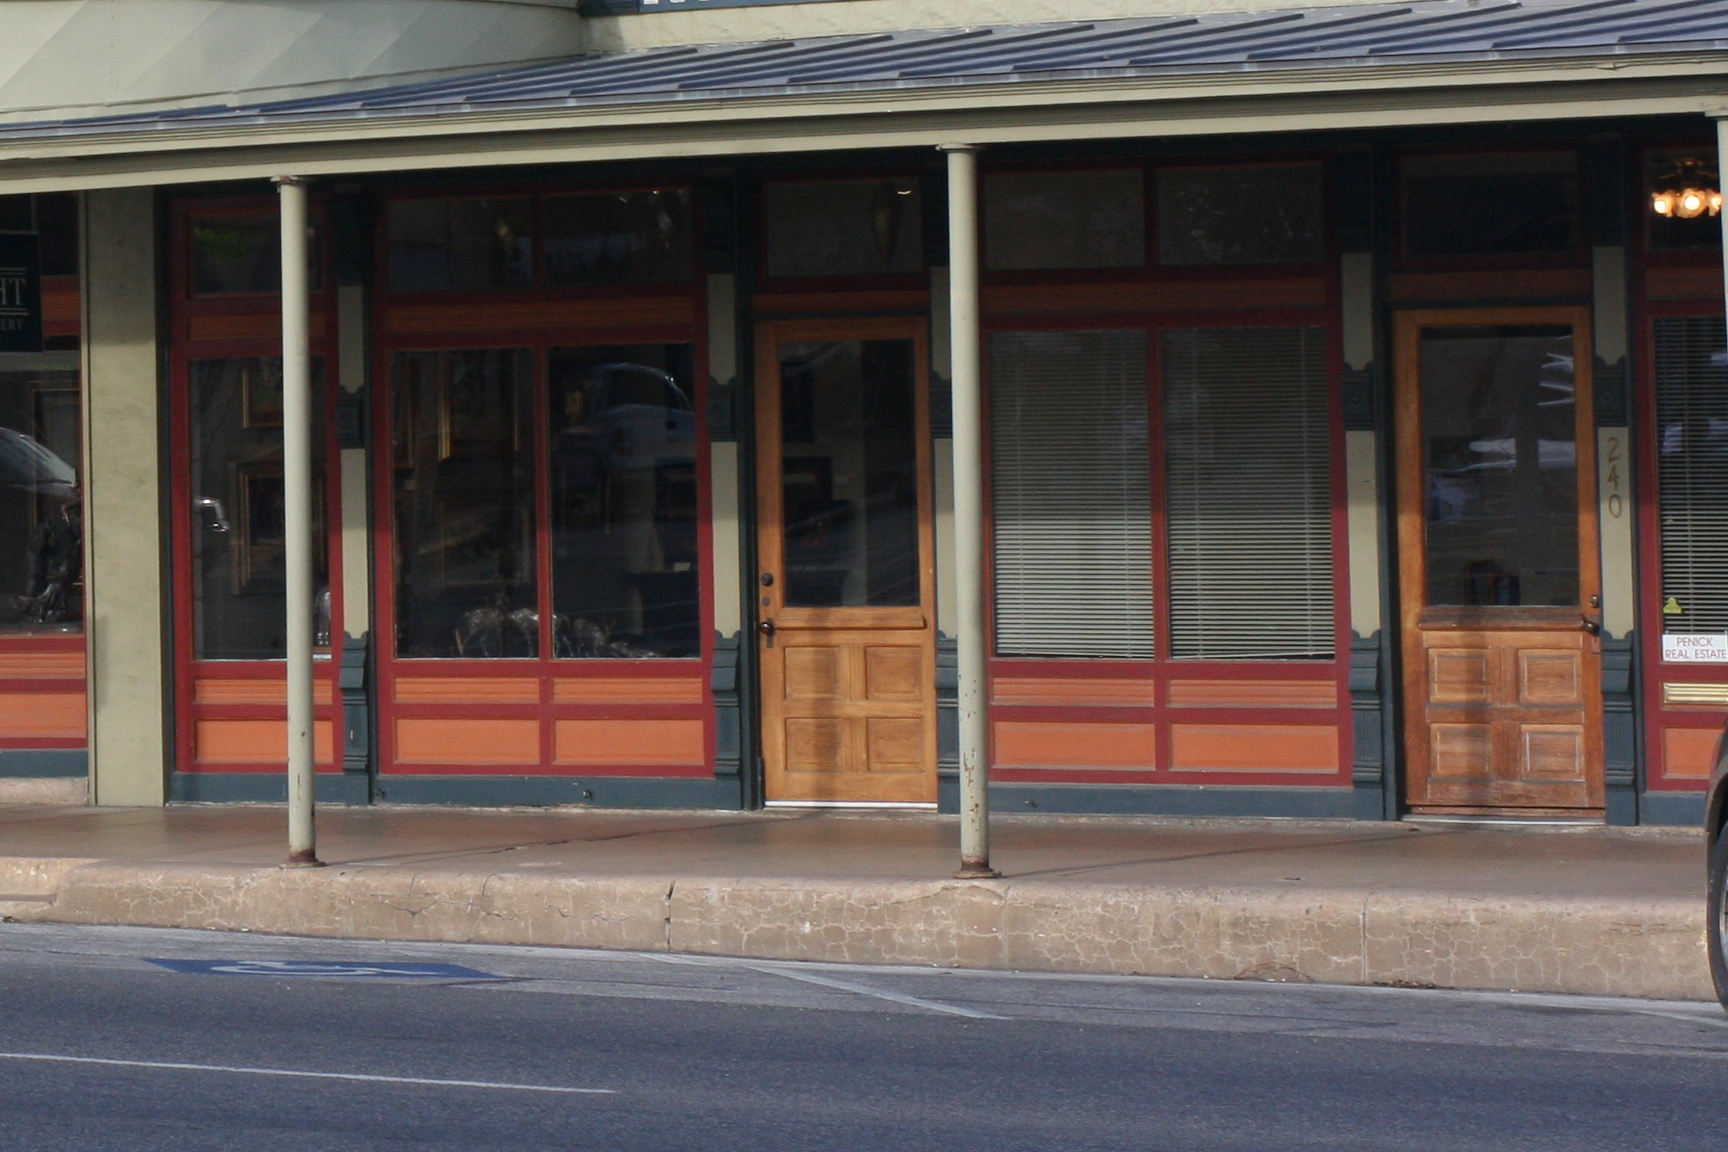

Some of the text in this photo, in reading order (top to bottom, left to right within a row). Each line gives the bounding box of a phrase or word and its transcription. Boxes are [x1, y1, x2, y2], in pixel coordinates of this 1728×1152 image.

[1607, 436, 1623, 519] 240
[1676, 636, 1714, 647] PENICK
[1665, 648, 1727, 659] REAL ESTATE
